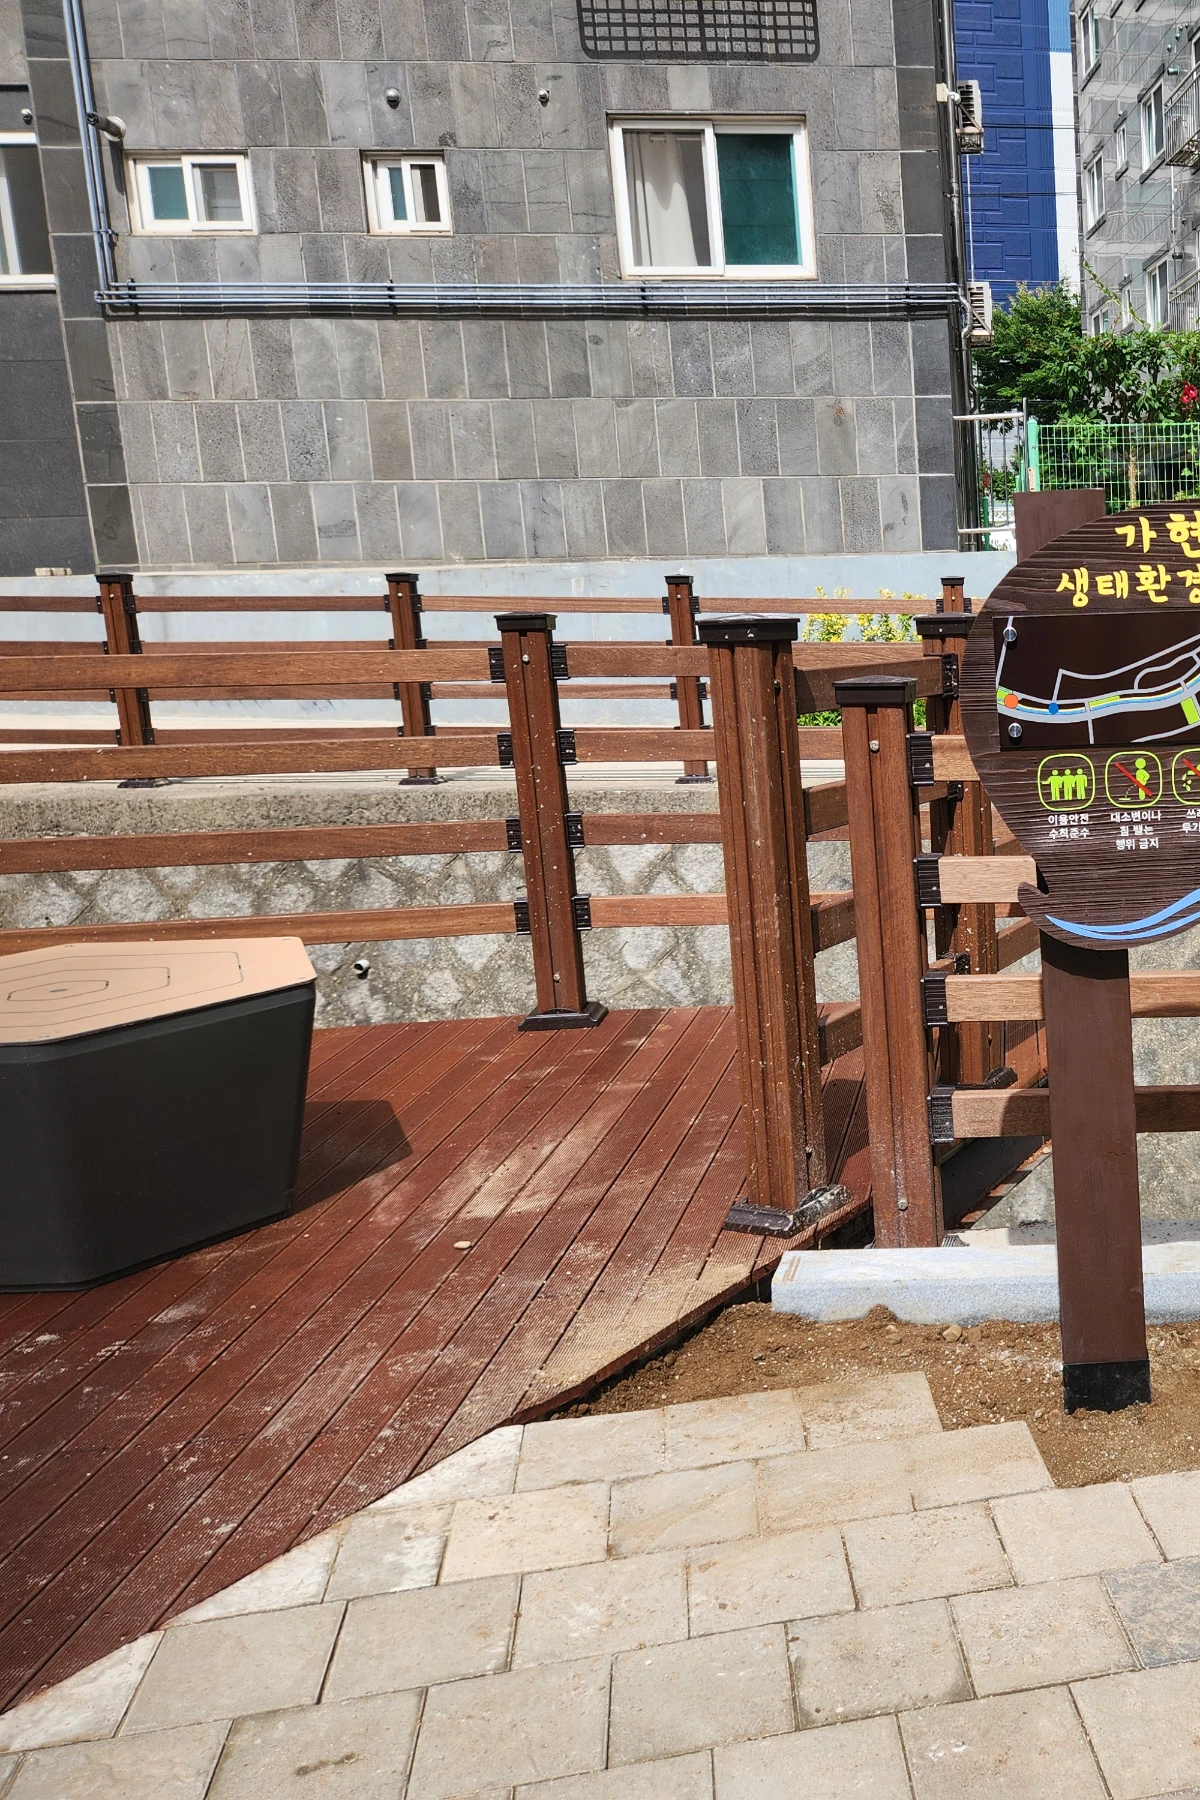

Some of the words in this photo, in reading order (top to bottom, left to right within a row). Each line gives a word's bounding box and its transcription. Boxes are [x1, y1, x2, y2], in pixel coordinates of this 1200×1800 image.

[1048, 813, 1090, 826] 이용안전
[1110, 810, 1162, 823] 대소변이나
[1115, 839, 1135, 851] 행위
[1138, 837, 1159, 849] 금지
